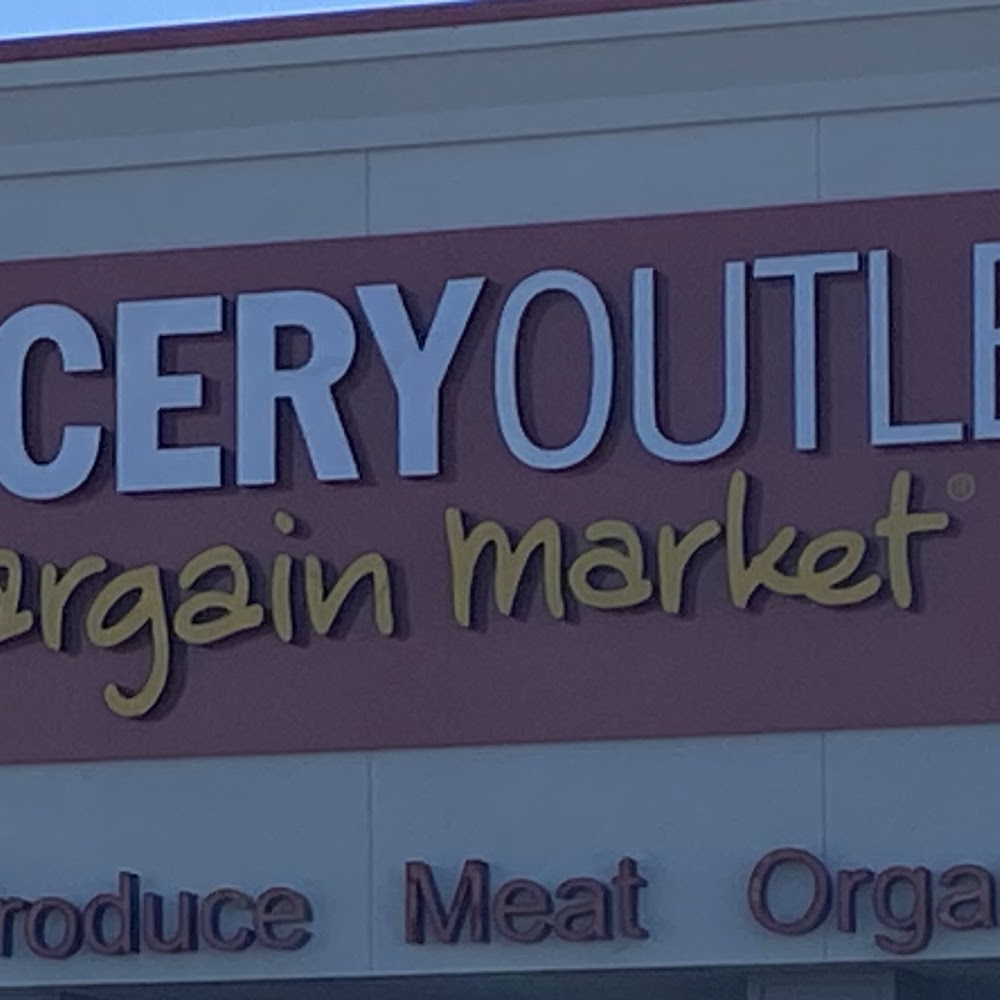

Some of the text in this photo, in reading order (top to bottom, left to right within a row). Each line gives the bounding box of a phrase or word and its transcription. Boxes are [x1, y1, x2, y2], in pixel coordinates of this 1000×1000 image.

[444, 468, 950, 628] market
[404, 855, 652, 945] Meat
[747, 846, 999, 956] Orga
